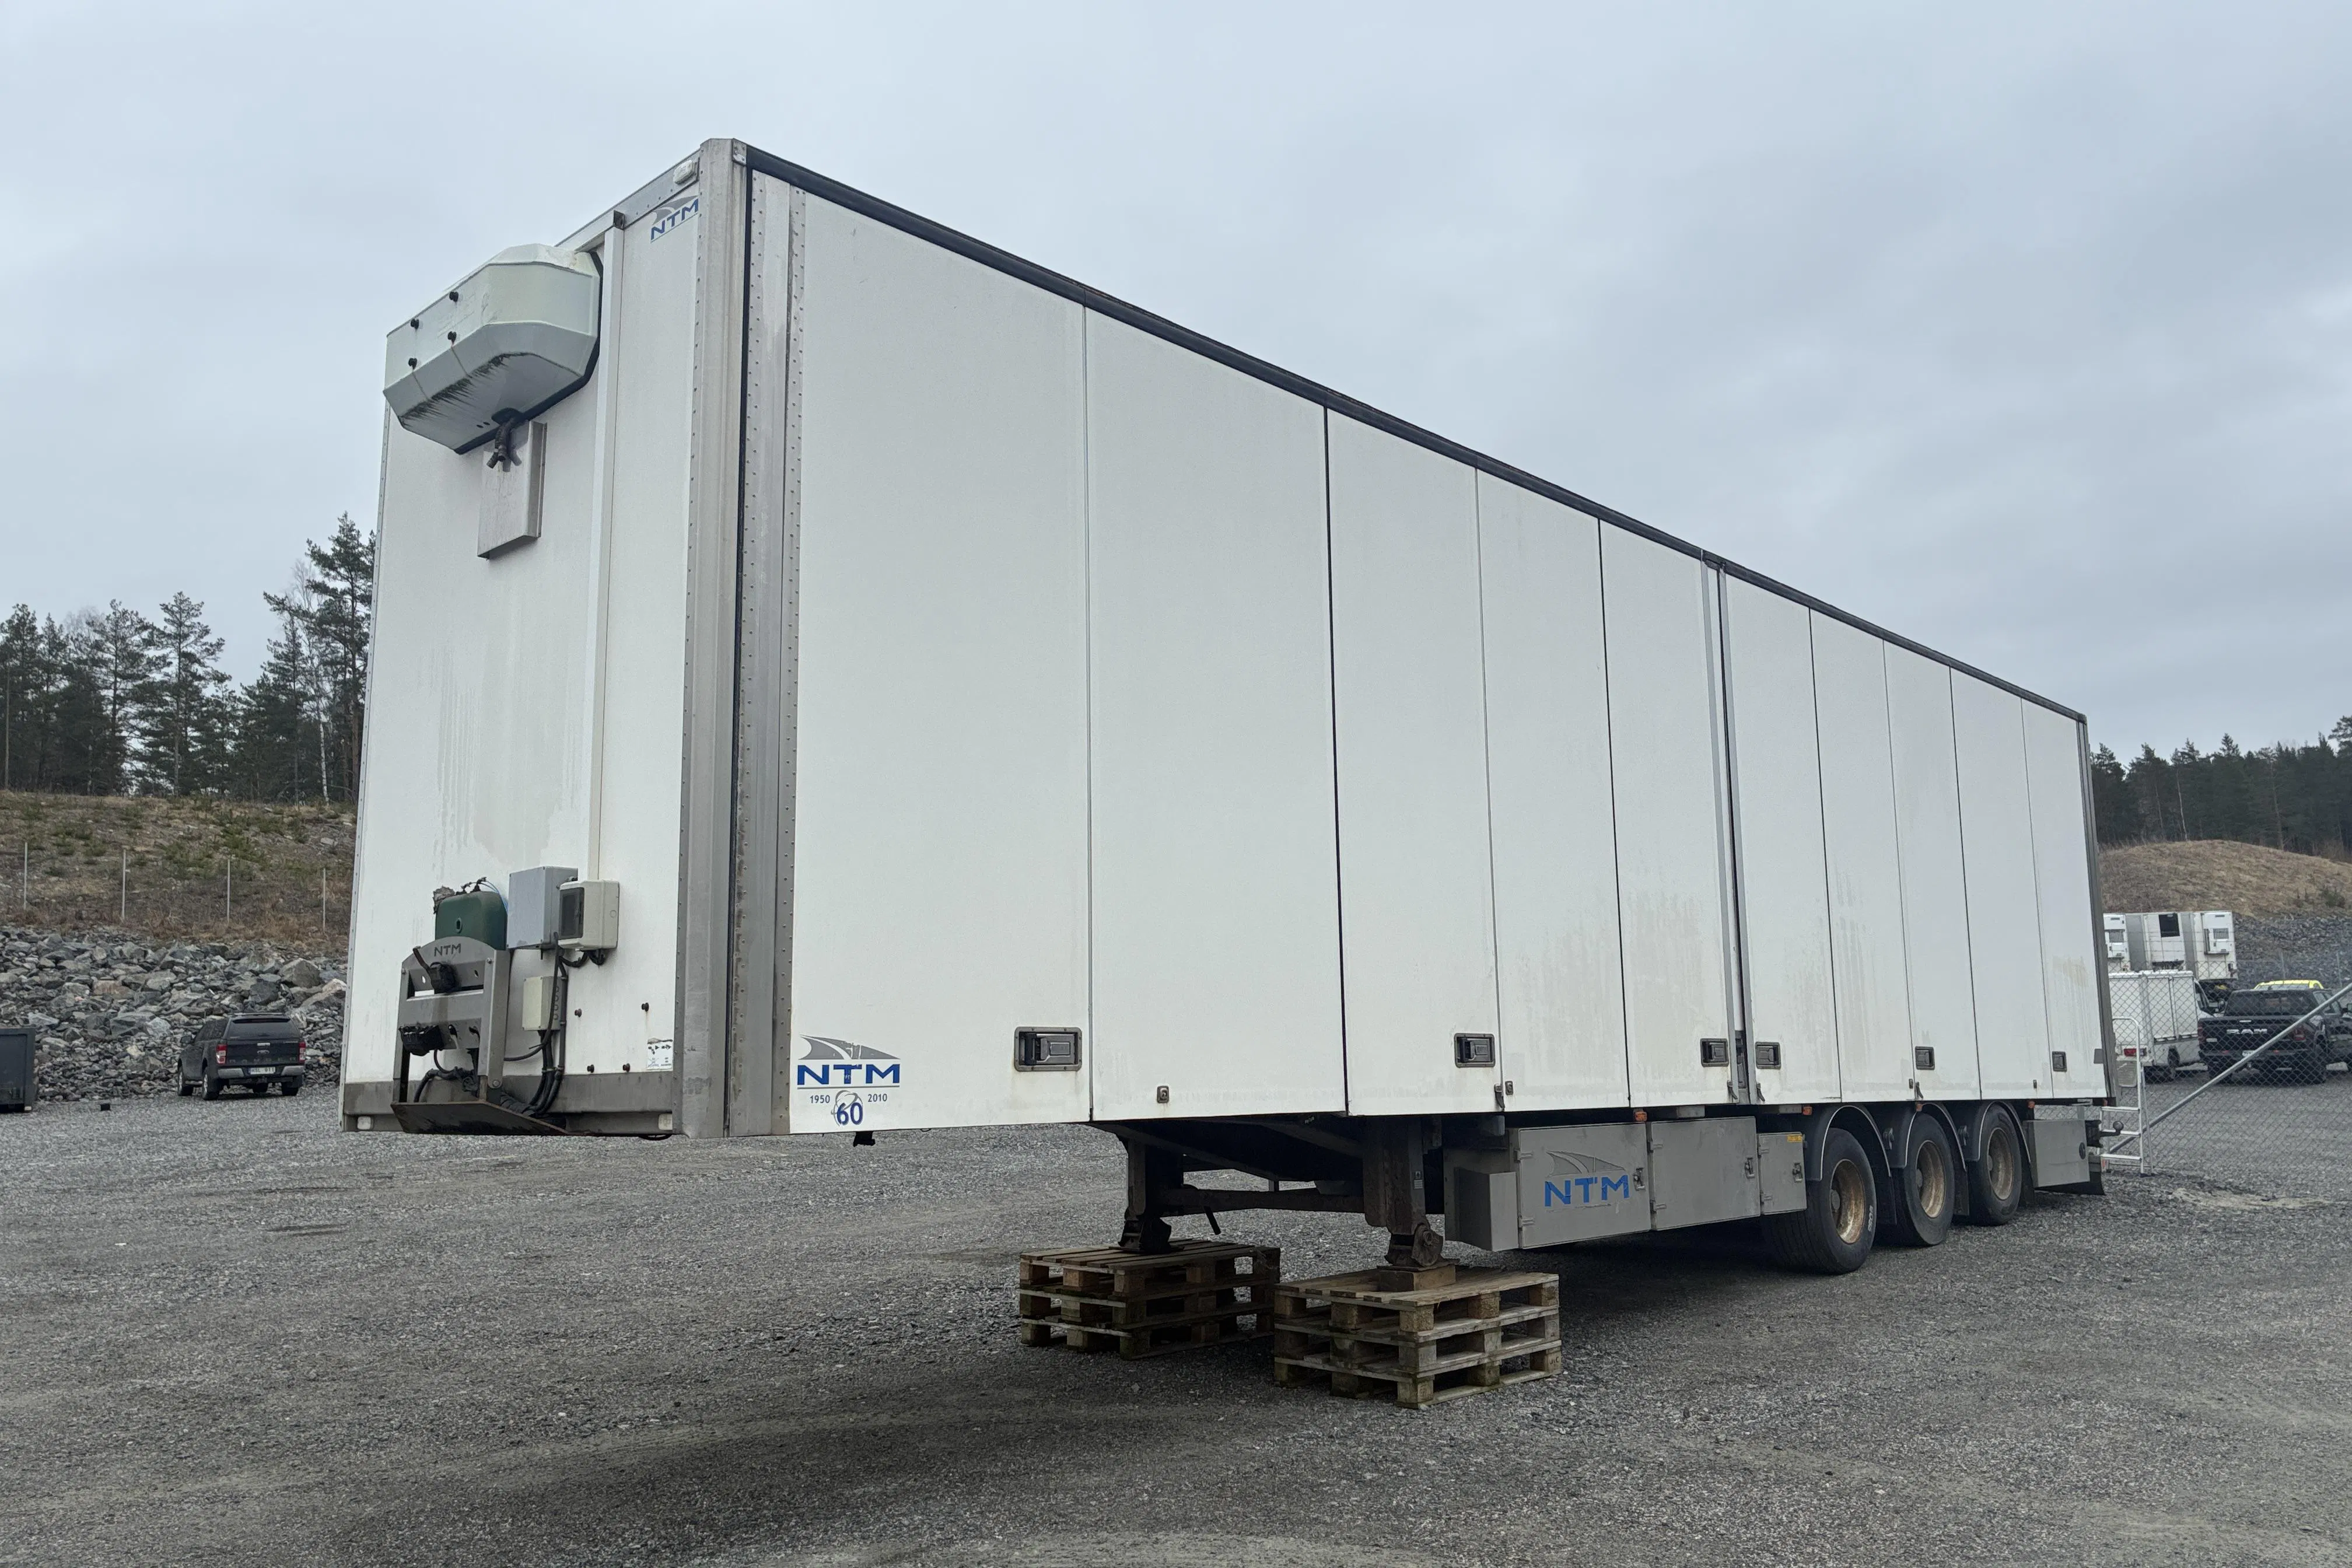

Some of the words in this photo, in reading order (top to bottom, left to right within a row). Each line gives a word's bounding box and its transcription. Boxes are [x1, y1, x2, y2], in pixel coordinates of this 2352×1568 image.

[651, 198, 699, 240] NTM
[434, 943, 461, 957] NTM
[797, 1064, 900, 1085] NTM
[810, 1095, 830, 1104] 1950
[867, 1094, 888, 1102] 2010
[836, 1102, 863, 1126] 60
[1545, 1175, 1629, 1207] NTM
